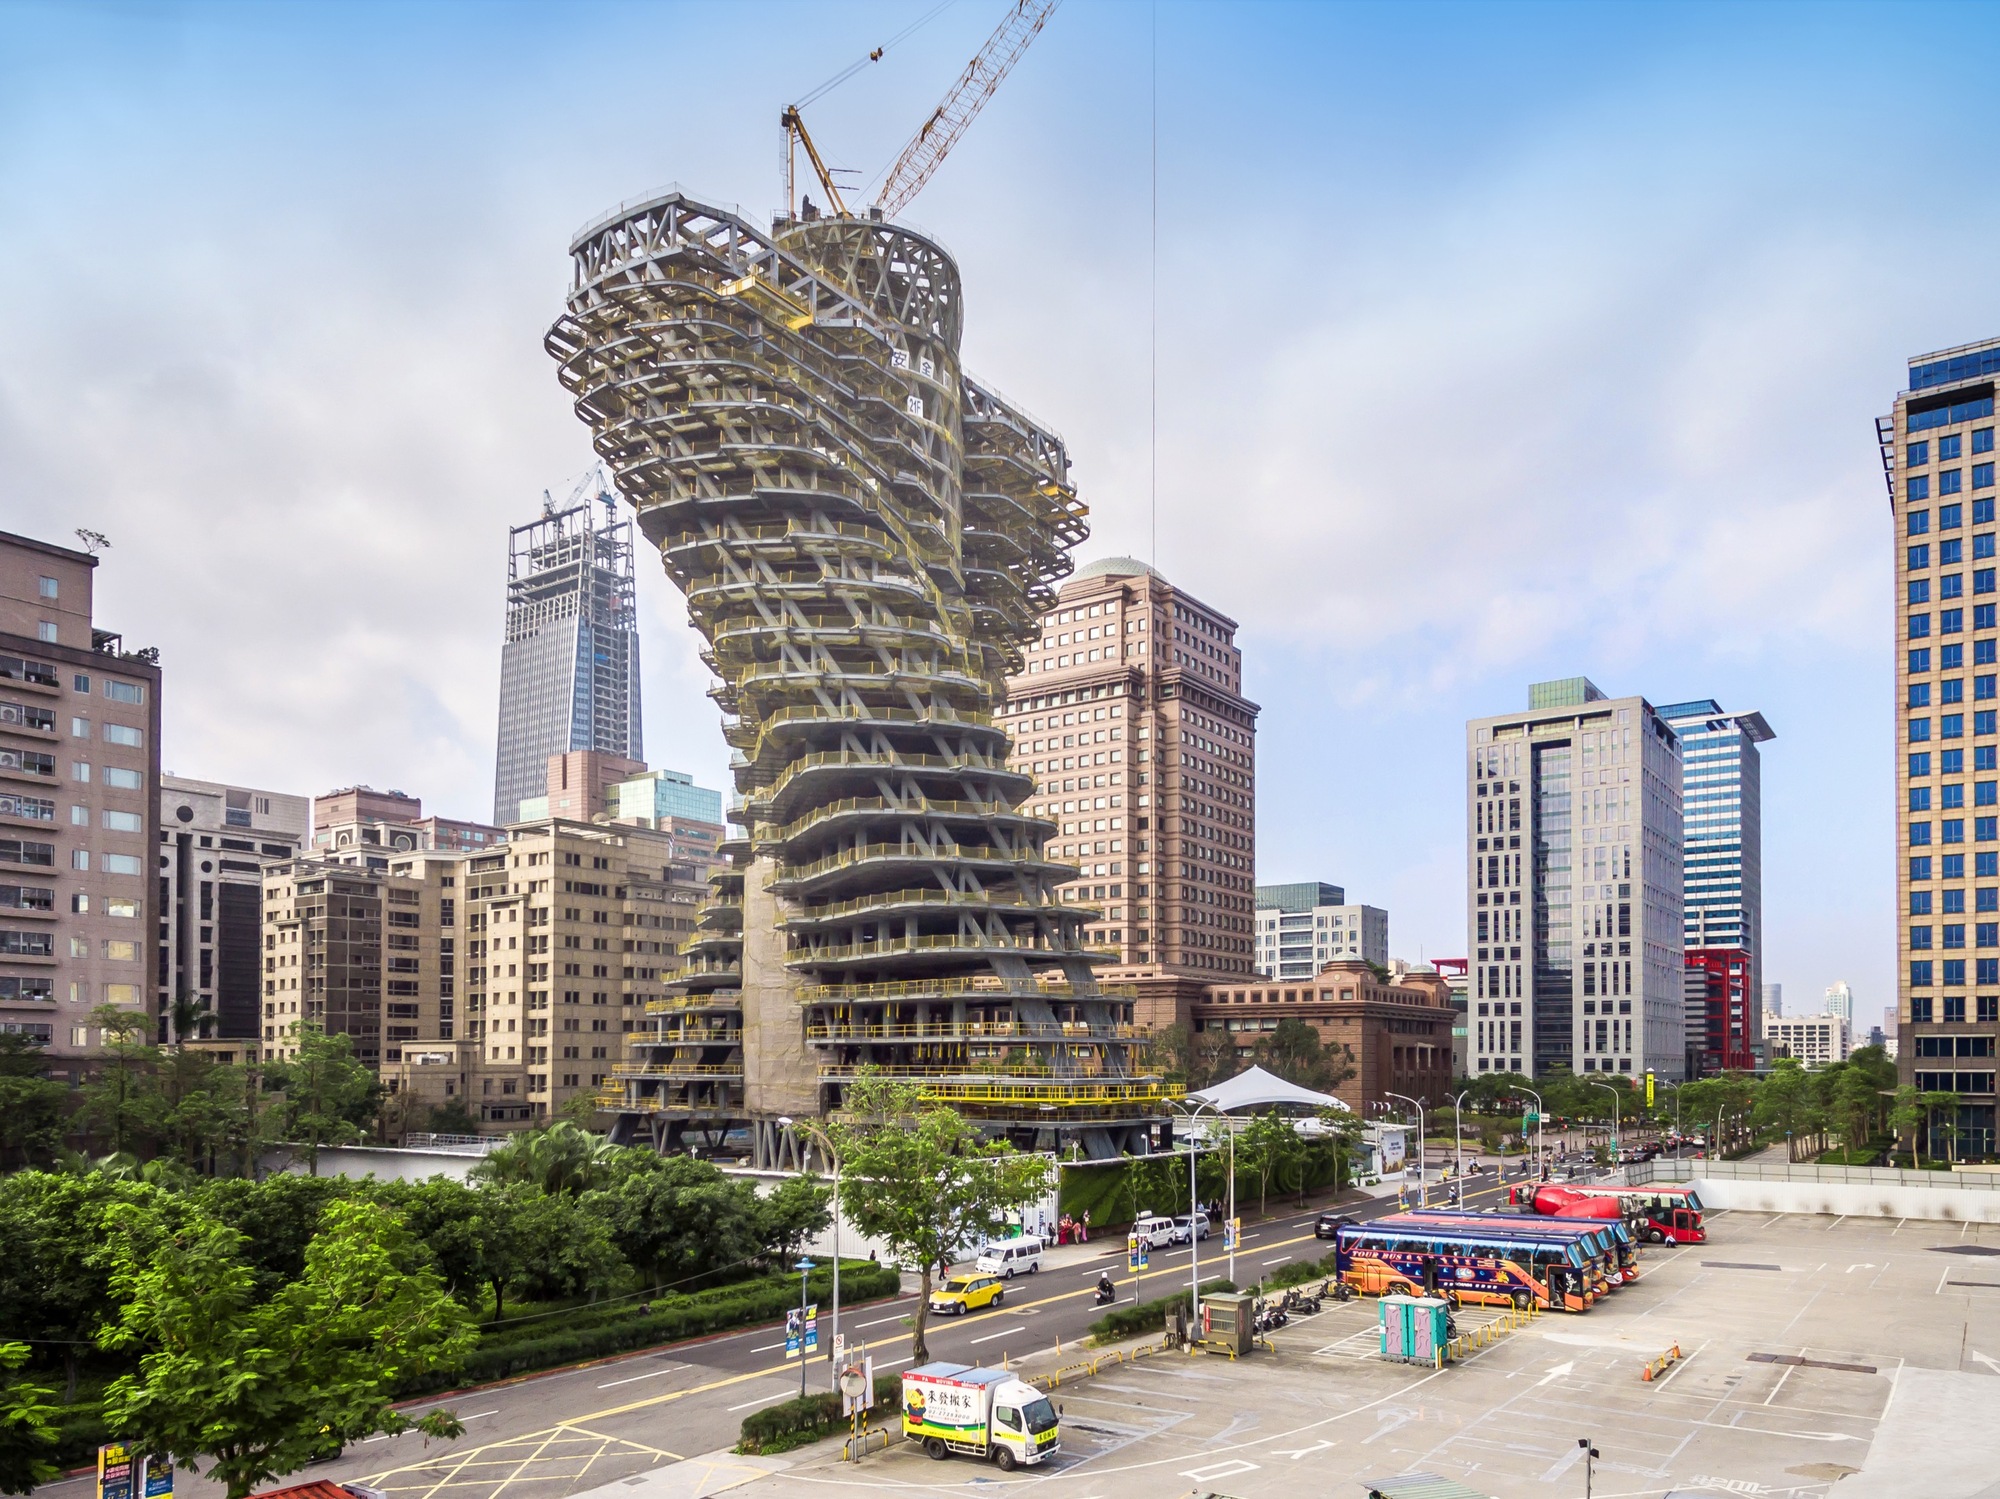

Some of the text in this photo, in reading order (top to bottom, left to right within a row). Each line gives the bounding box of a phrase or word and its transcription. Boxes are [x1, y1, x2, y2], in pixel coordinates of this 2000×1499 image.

[909, 398, 921, 416] 21F
[1352, 1250, 1379, 1259] TOUR
[935, 1378, 954, 1386] MOVING
